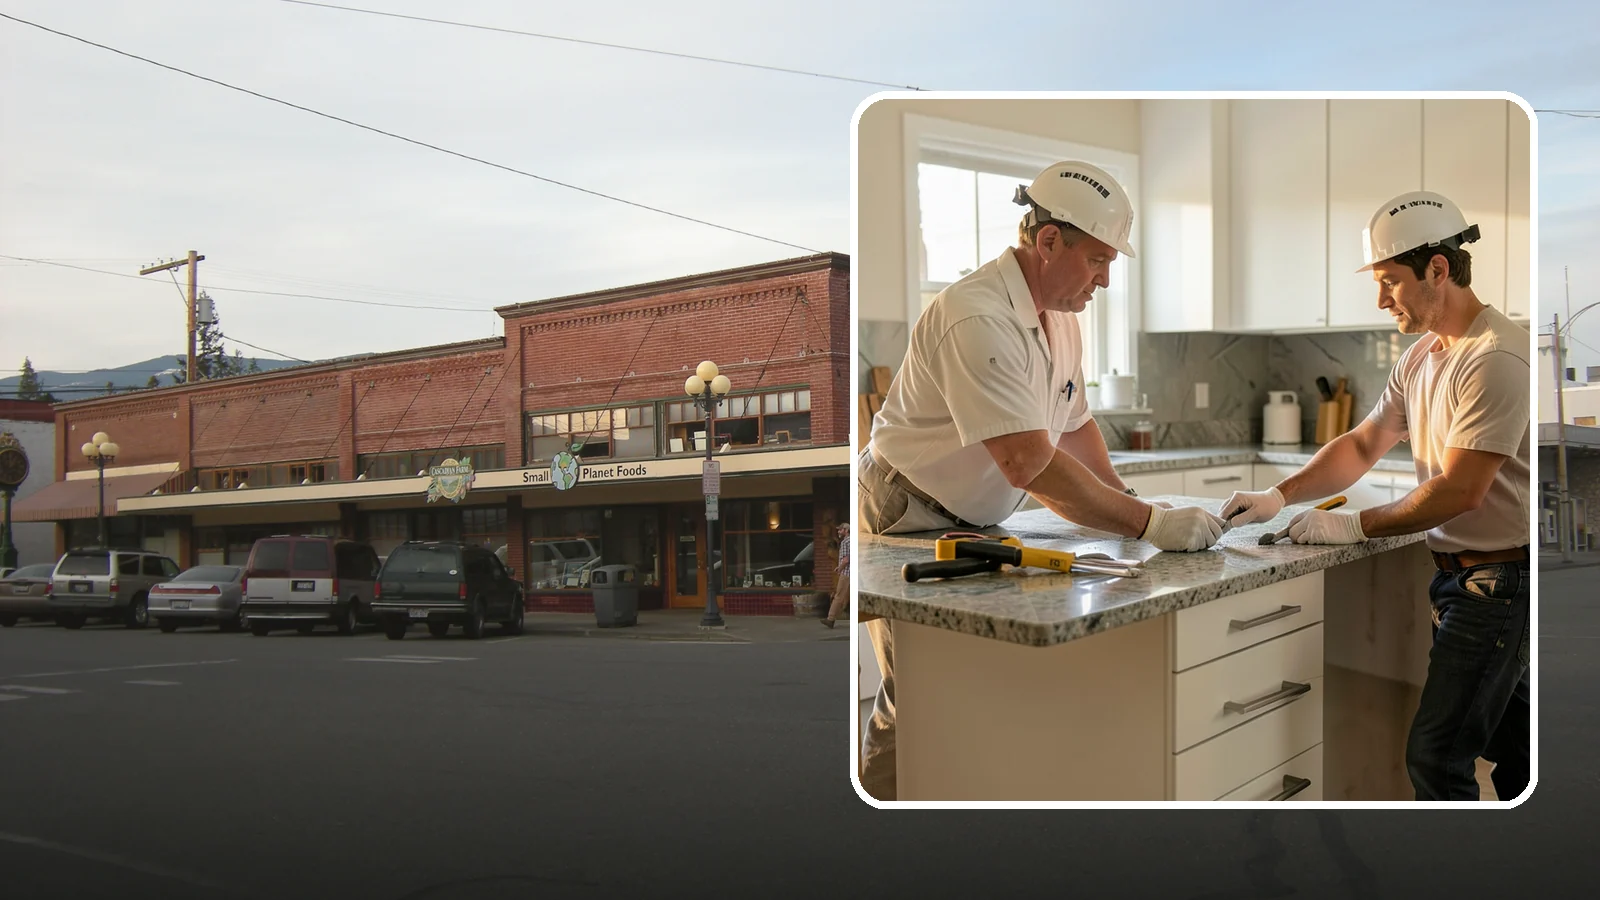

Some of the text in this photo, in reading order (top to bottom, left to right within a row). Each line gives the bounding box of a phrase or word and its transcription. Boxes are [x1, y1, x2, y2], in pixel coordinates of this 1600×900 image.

[523, 464, 647, 483] Small Planet Foods
